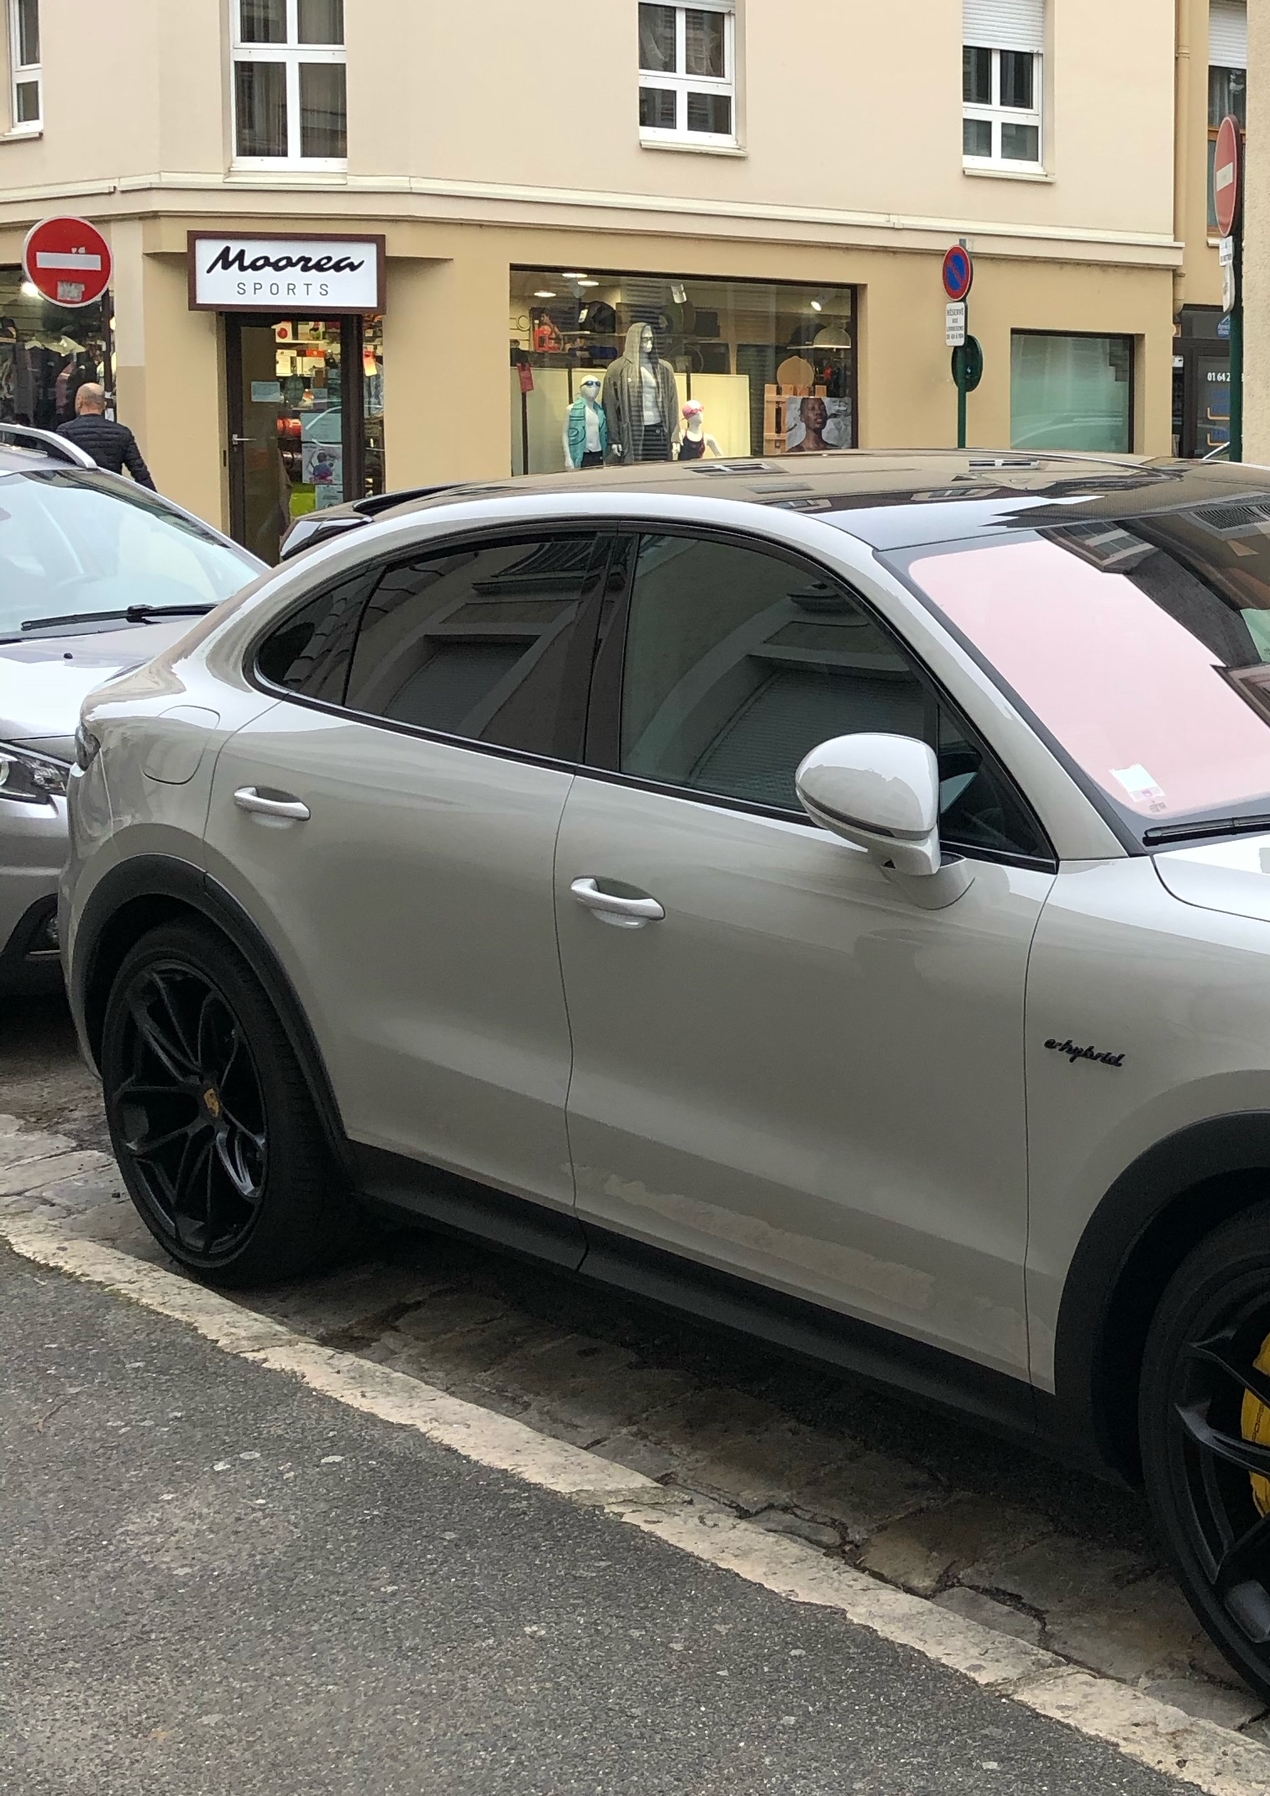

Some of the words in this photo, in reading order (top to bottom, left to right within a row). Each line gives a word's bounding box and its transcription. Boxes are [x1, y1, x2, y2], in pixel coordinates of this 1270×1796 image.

[206, 245, 365, 274] Moorea
[236, 282, 329, 297] SPORTS
[1207, 372, 1216, 382] 01
[1217, 372, 1226, 382] 64
[1043, 1038, 1126, 1068] e-hybrid
